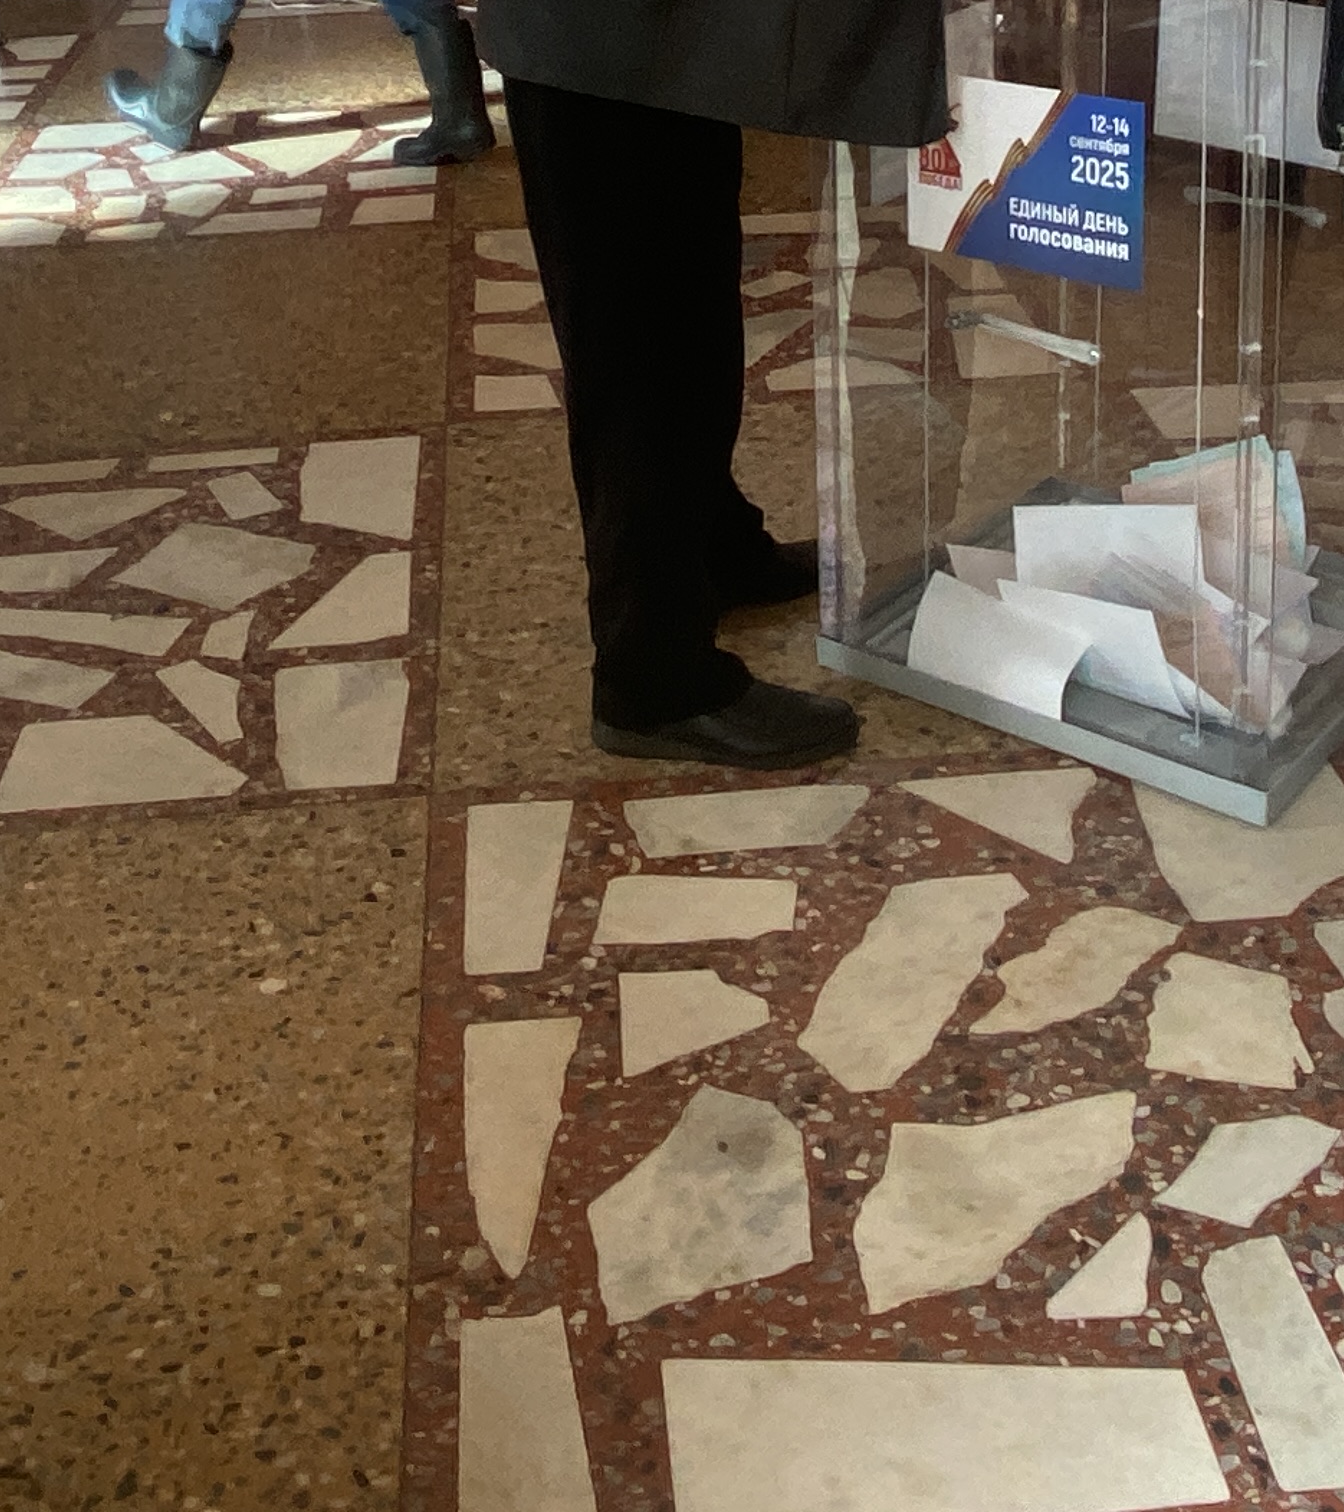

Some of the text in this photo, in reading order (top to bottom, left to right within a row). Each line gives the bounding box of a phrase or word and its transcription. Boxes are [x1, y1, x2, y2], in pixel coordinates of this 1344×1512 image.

[1090, 114, 1130, 138] 12-14
[1069, 135, 1130, 157] сентября
[1071, 155, 1130, 190] 2025
[1009, 197, 1129, 236] ЕДИНЫЙ ДЕНЬ
[1009, 223, 1130, 261] голосования
